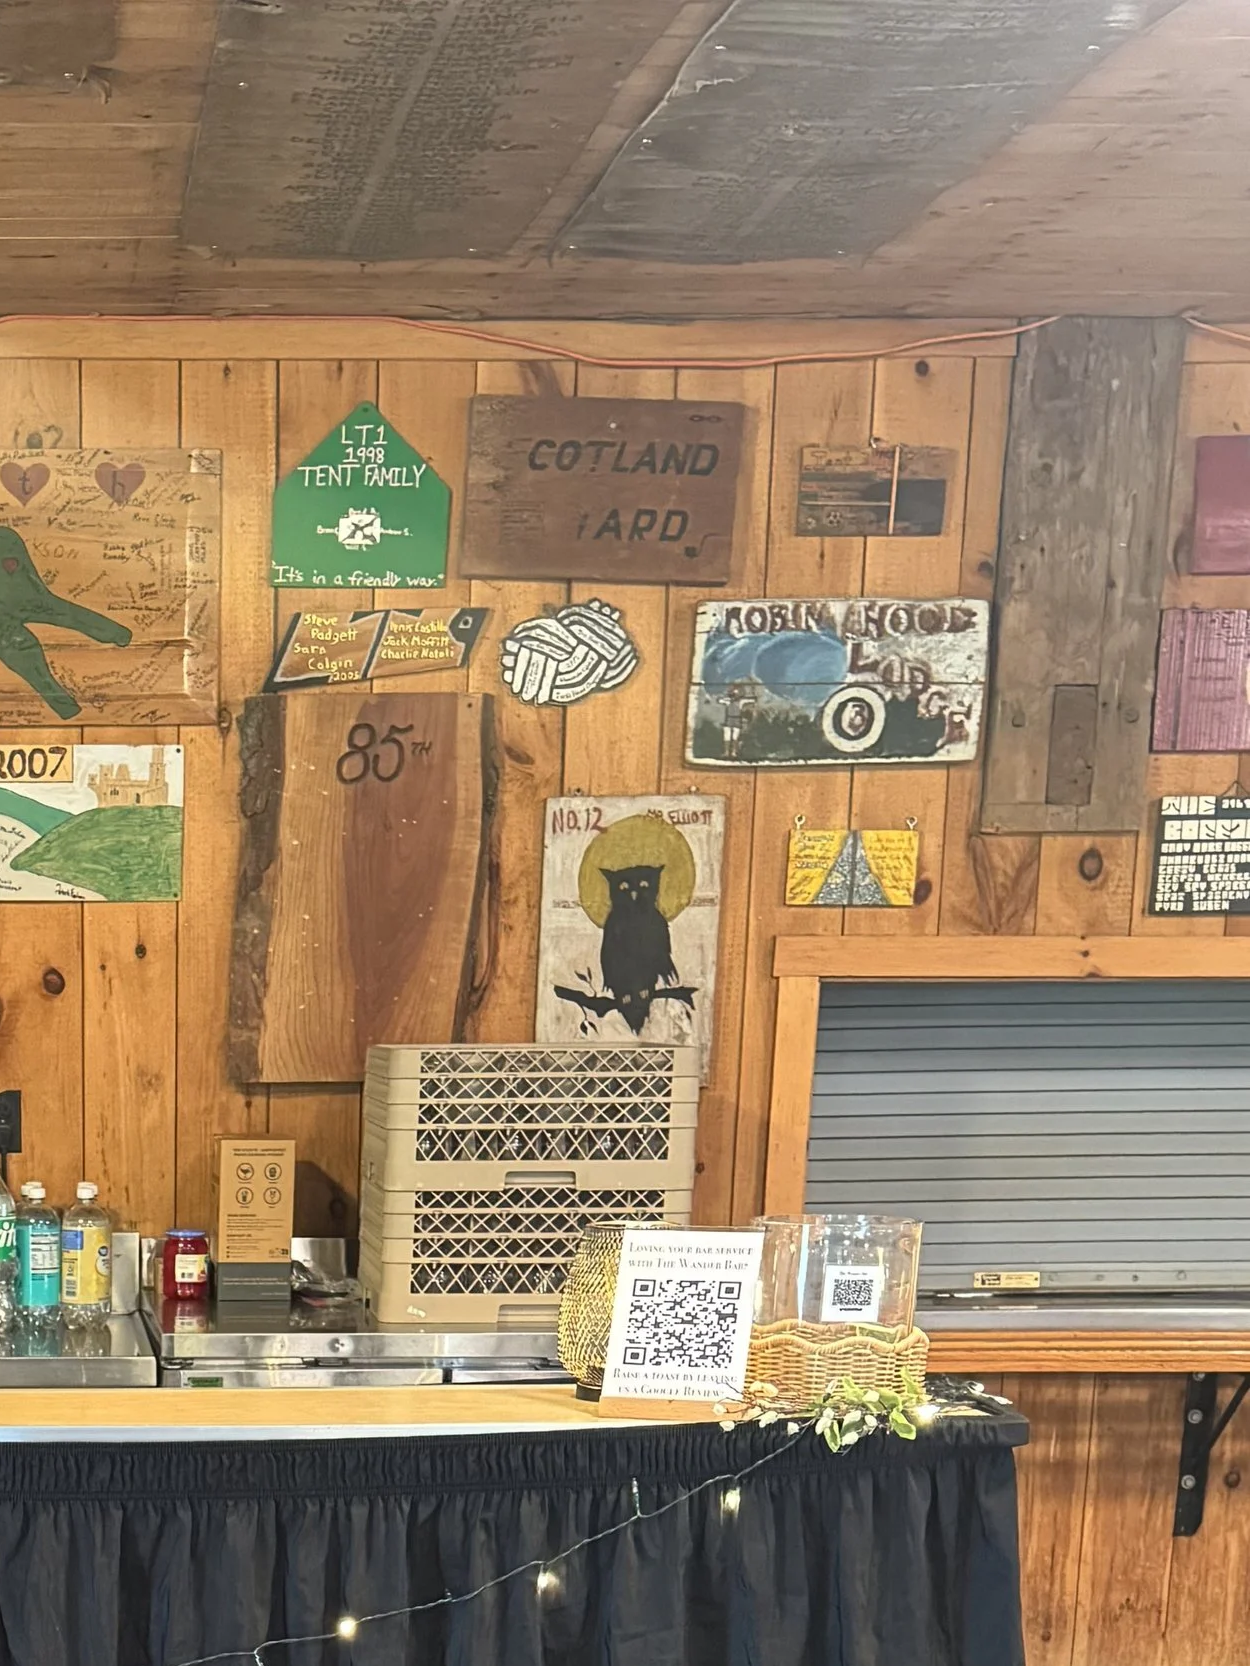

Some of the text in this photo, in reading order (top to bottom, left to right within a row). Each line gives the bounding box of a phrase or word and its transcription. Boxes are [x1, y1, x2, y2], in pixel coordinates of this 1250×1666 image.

[343, 447, 385, 464] 1998
[528, 440, 720, 476] COTLAND
[297, 464, 426, 489] TENT FAMILY
[313, 570, 326, 584] in
[333, 574, 343, 585] a
[348, 570, 401, 588] friendly
[311, 629, 358, 644] Padgett
[383, 635, 409, 646] Jack
[381, 648, 418, 659] Charlie
